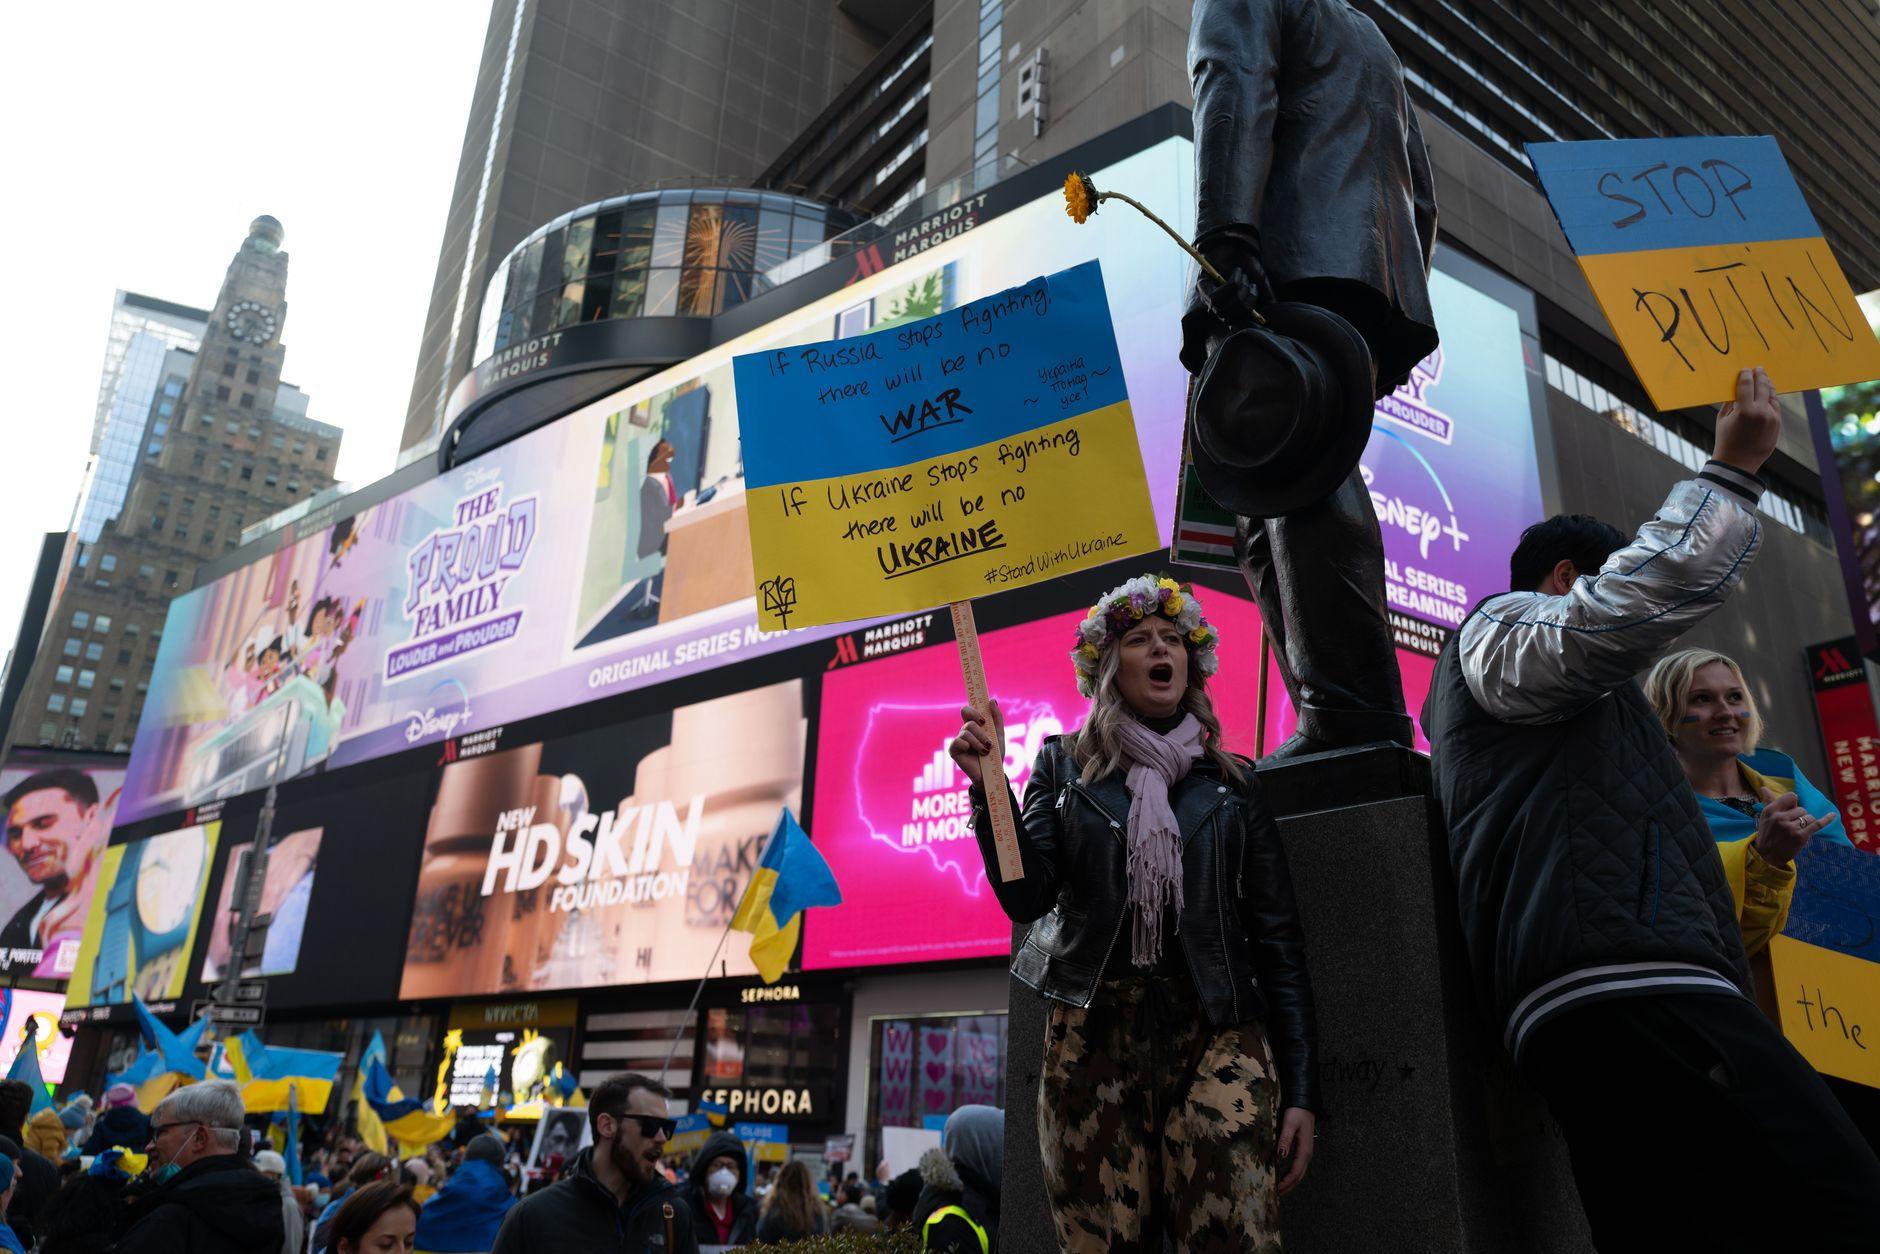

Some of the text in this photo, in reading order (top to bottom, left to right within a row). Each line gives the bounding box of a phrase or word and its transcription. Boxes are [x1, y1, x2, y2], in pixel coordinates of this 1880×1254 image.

[1597, 159, 1752, 228] STOP
[895, 194, 987, 246] MARRIOTT
[895, 217, 974, 263] MARQUIS
[1632, 251, 1853, 372] PUTIN
[768, 352, 790, 376] If
[801, 342, 883, 373] Russia
[818, 344, 1010, 404] there will be no
[880, 388, 973, 437] WAR
[1384, 396, 1446, 436] PROUDER
[781, 486, 807, 517] If
[827, 473, 913, 510] Ukraine
[998, 429, 1080, 473] fighting
[456, 487, 499, 527] THE
[842, 485, 1025, 540] there will be no
[406, 497, 537, 613] PROUD
[877, 519, 1004, 575] UKRAINE
[1386, 581, 1466, 625] REAMING
[1405, 566, 1467, 605] SERIES
[413, 578, 507, 639] FAMILY
[863, 615, 933, 642] MARRIOTT
[389, 642, 438, 675] LOUDER
[455, 617, 516, 653] PROUDER
[863, 632, 924, 658] MARQUIS
[1394, 631, 1440, 654] ARQUIS
[588, 652, 671, 689] ORIGINAL
[674, 639, 741, 666] SERIES
[405, 707, 473, 743] Disney+
[462, 727, 503, 746] MARRIOTT
[459, 740, 496, 758] MARQUIS
[912, 793, 970, 820] MORE
[1834, 740, 1869, 844] NEW YORK
[496, 806, 538, 832] NEW
[902, 819, 978, 847] IN MOR
[481, 794, 706, 896] HD SKIN
[550, 869, 689, 914] FOUNDATION
[741, 986, 800, 1004] SEPHORA
[1796, 984, 1867, 1050] the
[887, 1028, 910, 1053] W
[886, 1058, 909, 1083] W
[701, 1089, 812, 1115] SEPHORA
[882, 1086, 907, 1111] W
